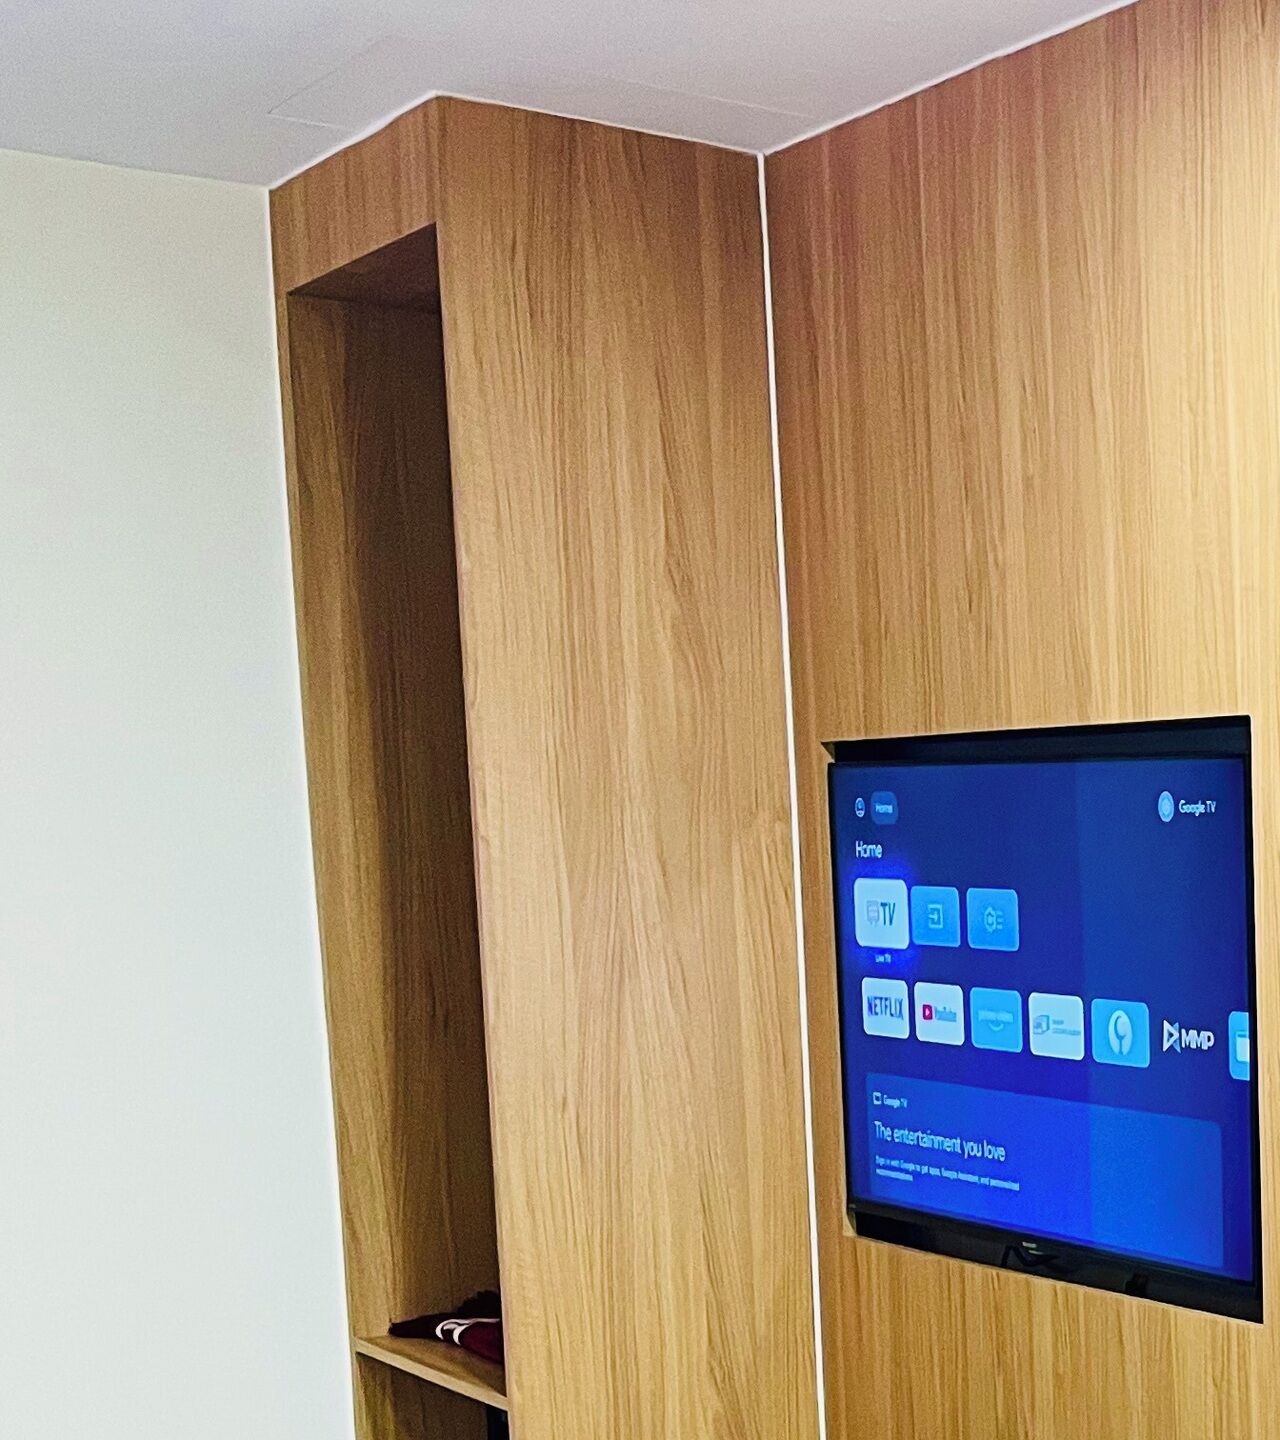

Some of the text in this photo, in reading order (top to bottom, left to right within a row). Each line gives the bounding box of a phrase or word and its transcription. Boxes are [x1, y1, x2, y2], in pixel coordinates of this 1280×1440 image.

[1179, 799, 1217, 816] Google TV
[855, 840, 883, 858] Home
[880, 902, 896, 926] TV
[867, 997, 904, 1020] NETFLIX
[1181, 1028, 1215, 1050] MMP
[874, 1121, 1006, 1162] The entertainment you love
